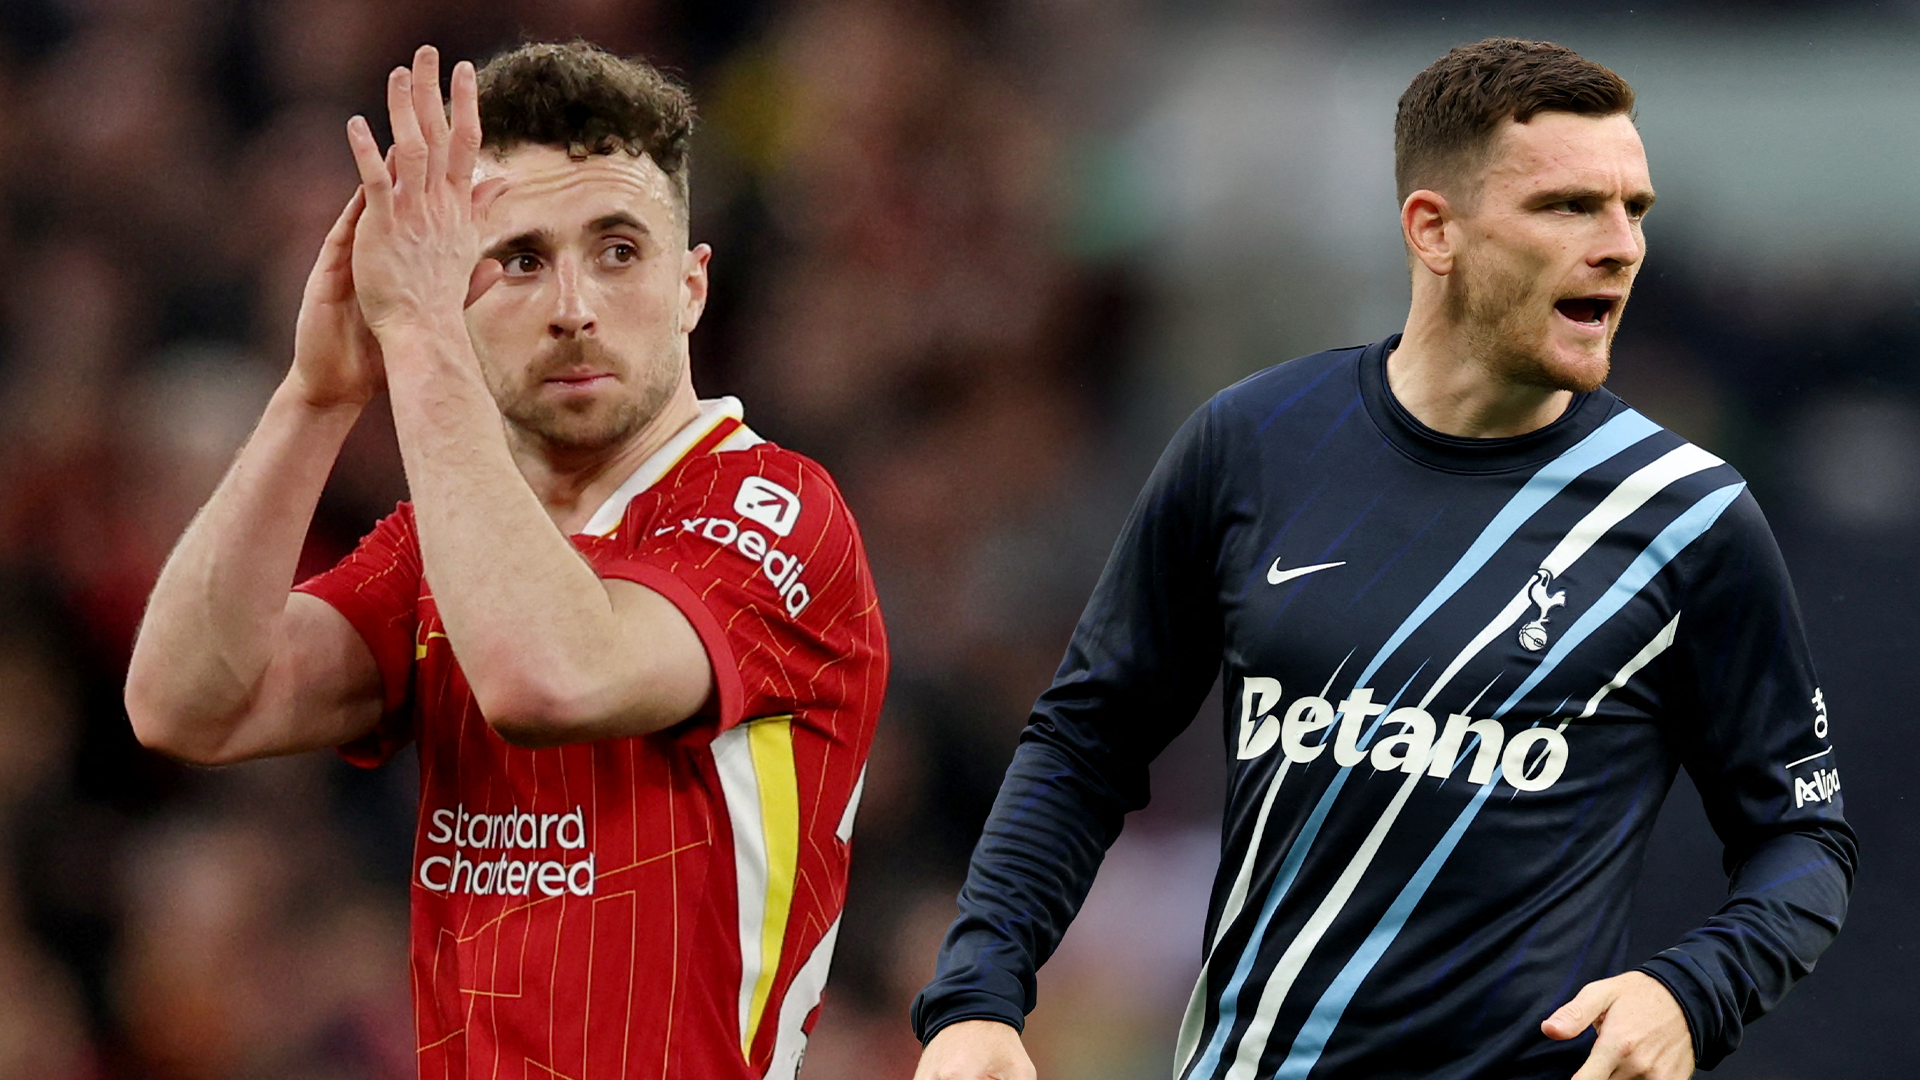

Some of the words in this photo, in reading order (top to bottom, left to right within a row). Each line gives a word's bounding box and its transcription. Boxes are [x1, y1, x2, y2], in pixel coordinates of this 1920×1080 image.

[655, 516, 811, 619] xpedia
[1236, 676, 1569, 792] Betano
[1794, 767, 1841, 809] Alipa
